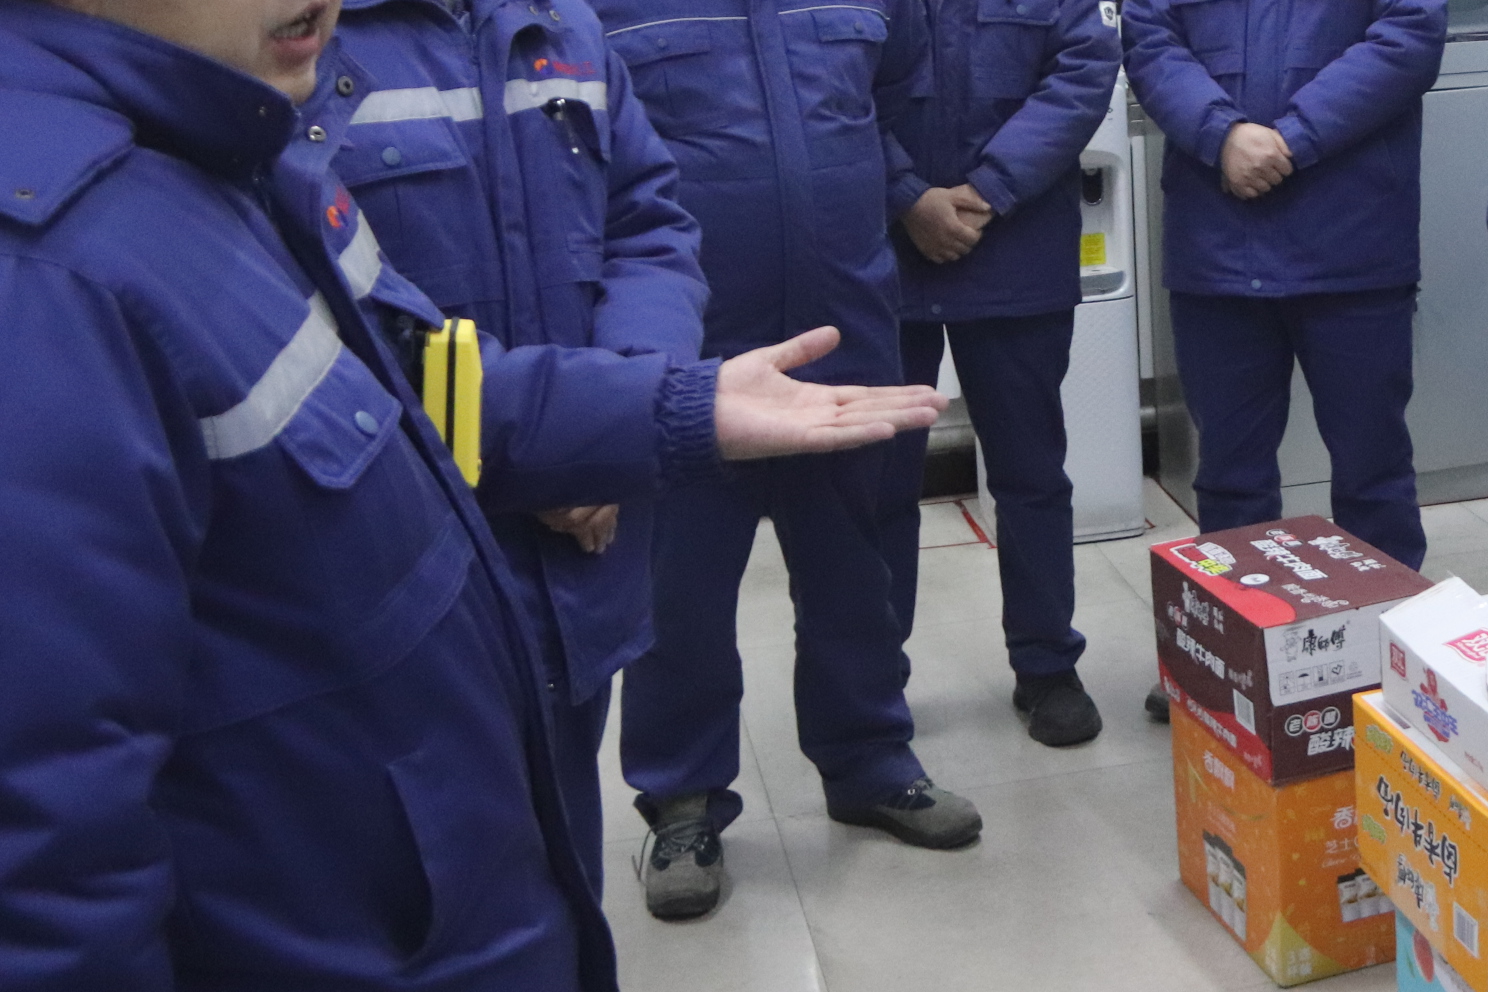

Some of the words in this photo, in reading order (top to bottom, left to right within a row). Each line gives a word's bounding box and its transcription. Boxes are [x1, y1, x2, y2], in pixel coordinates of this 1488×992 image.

[1376, 775, 1459, 885] 卤香牛肉面
